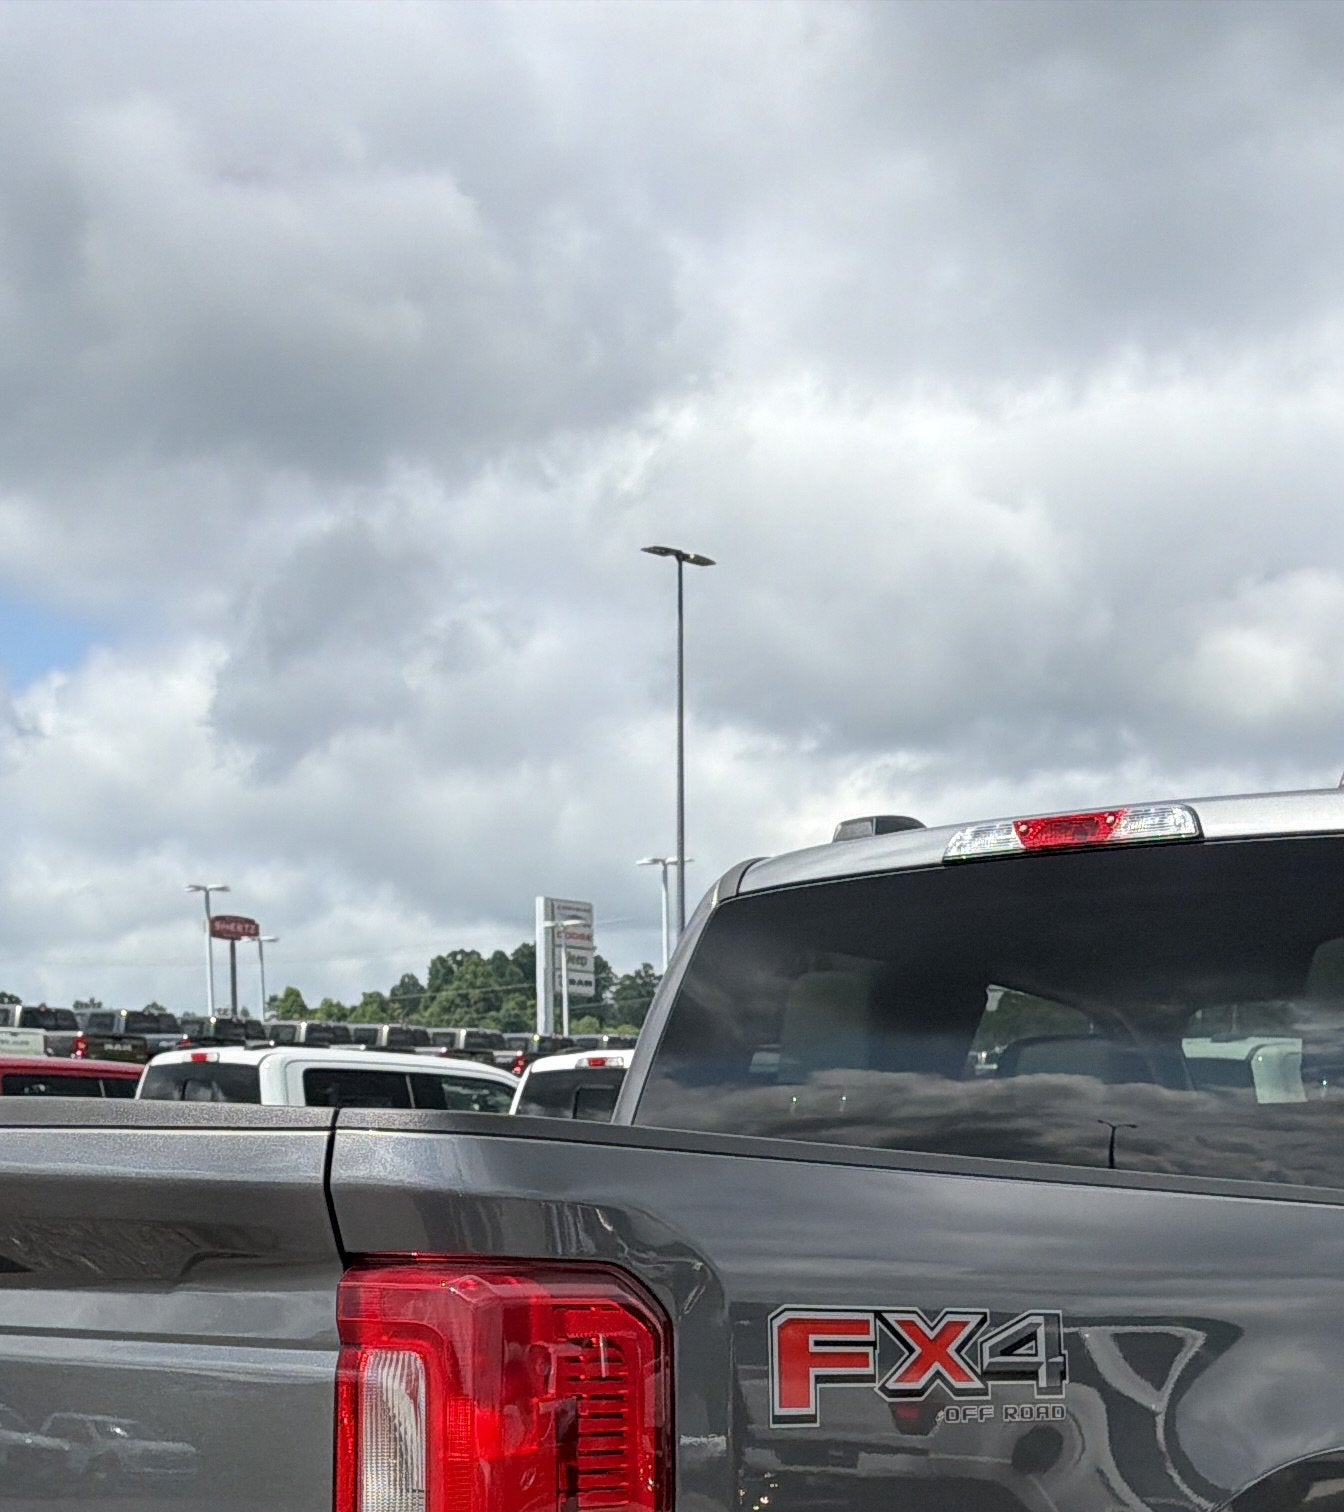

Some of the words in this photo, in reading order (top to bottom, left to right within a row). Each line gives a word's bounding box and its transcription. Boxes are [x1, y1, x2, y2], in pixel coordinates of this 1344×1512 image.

[767, 1303, 1069, 1428] FX4
[944, 1405, 994, 1424] OFF
[1002, 1404, 1066, 1422] ROAD
